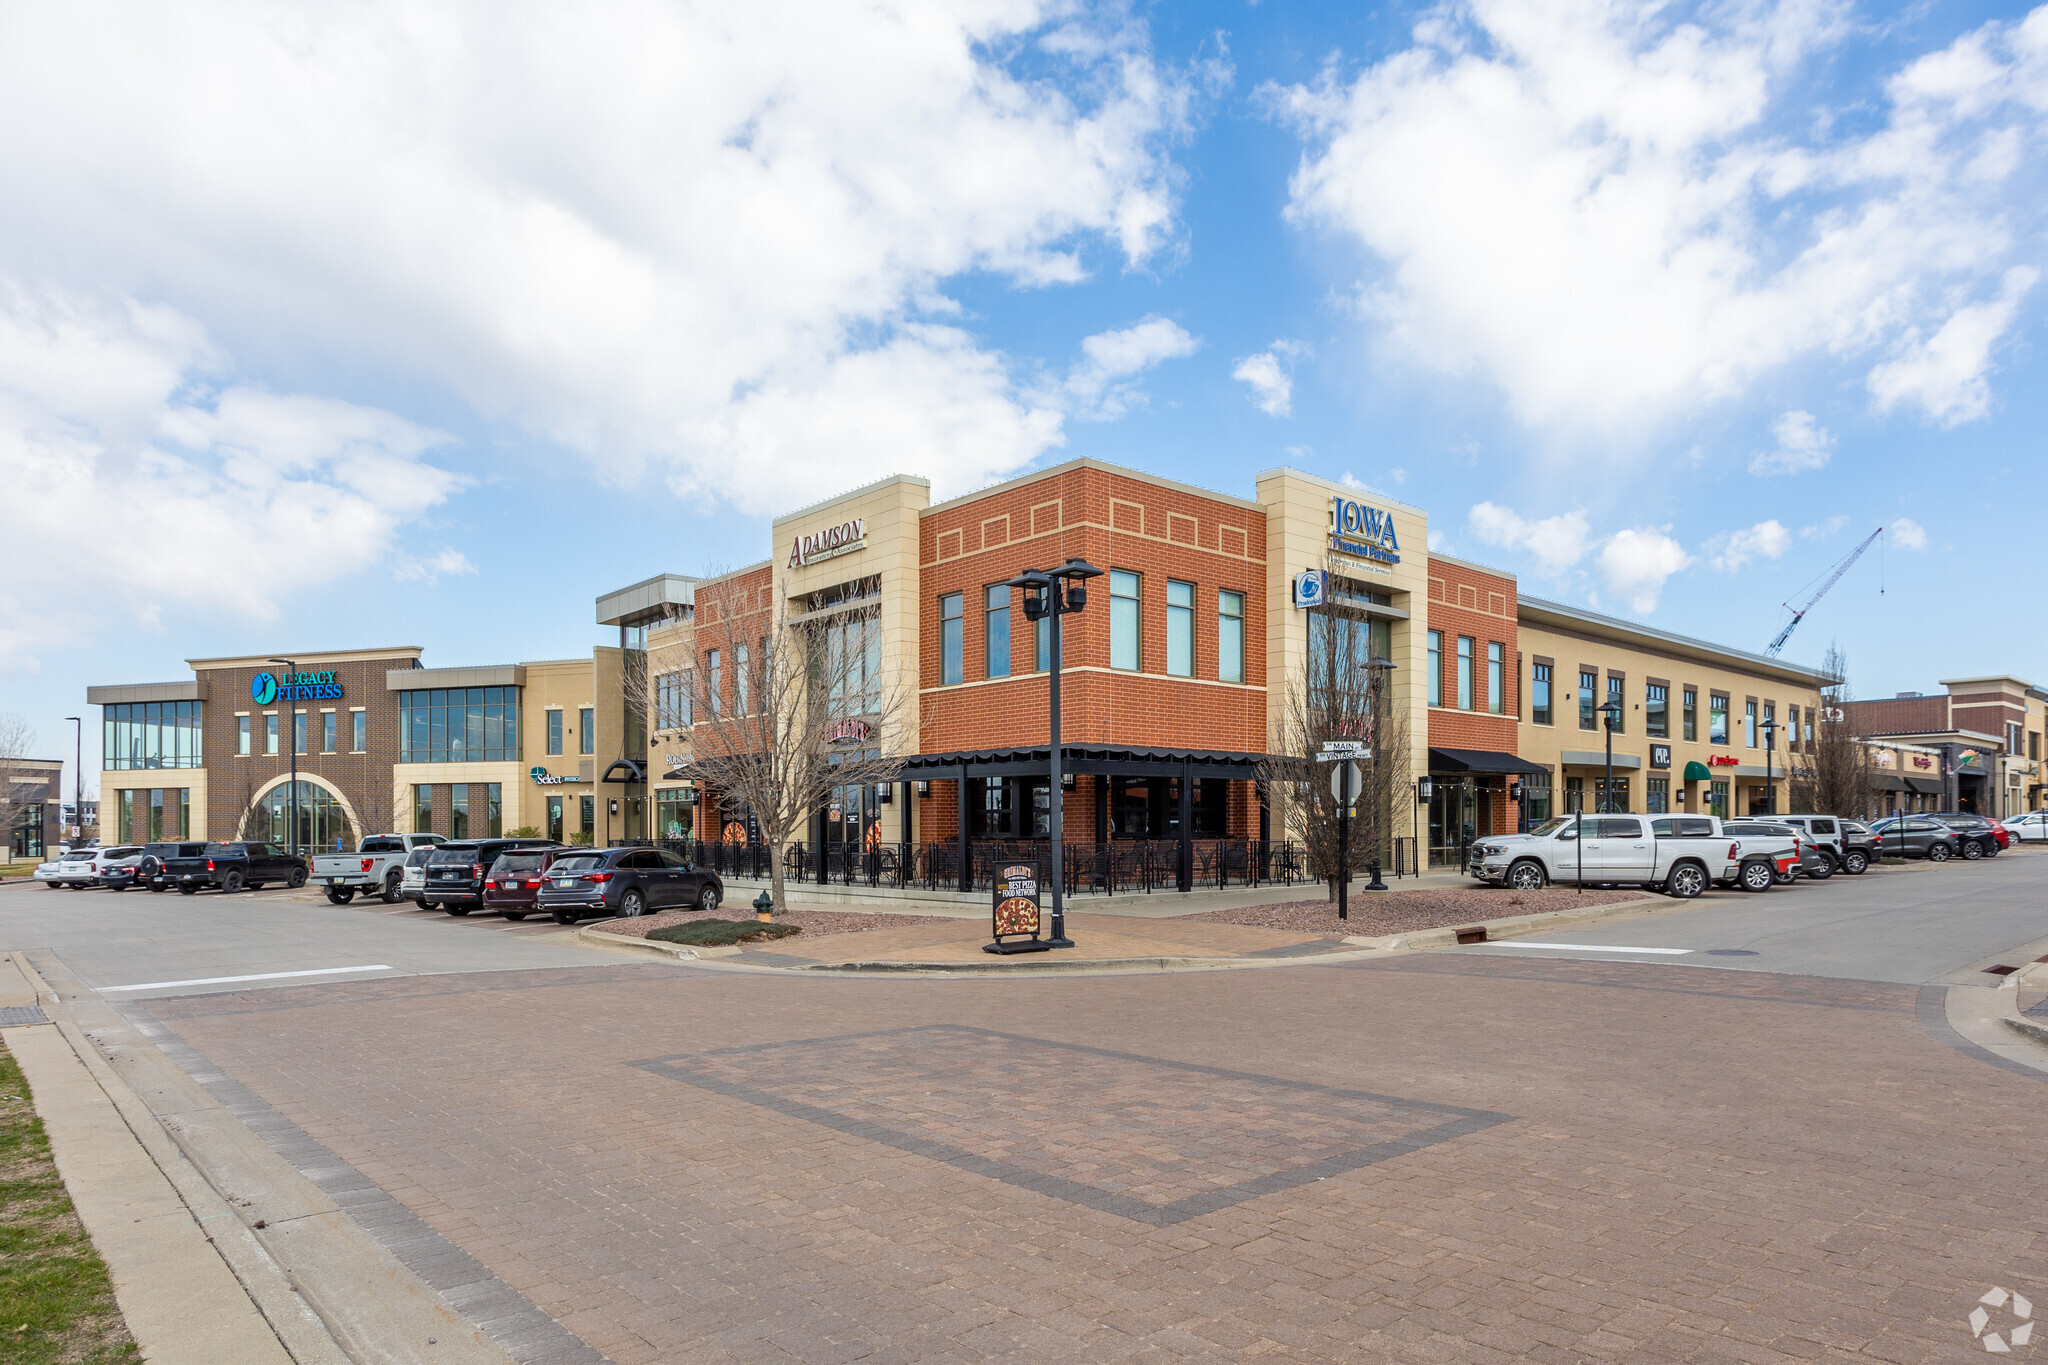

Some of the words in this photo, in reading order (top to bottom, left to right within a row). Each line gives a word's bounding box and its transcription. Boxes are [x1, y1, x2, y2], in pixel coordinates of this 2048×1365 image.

[1334, 497, 1400, 551] IOWA
[787, 518, 864, 569] ADAMSON
[837, 542, 864, 555] Associates
[1333, 537, 1368, 556] Financial
[1370, 546, 1401, 564] Partners
[281, 671, 336, 686] LEGACY
[275, 684, 342, 701] FITNESS
[1333, 742, 1354, 750] MAIN
[1326, 751, 1357, 760] VINTAGE
[1655, 747, 1670, 764] eve.
[537, 774, 562, 785] Select
[1008, 881, 1021, 890] BEST
[1022, 880, 1037, 889] PIZZA
